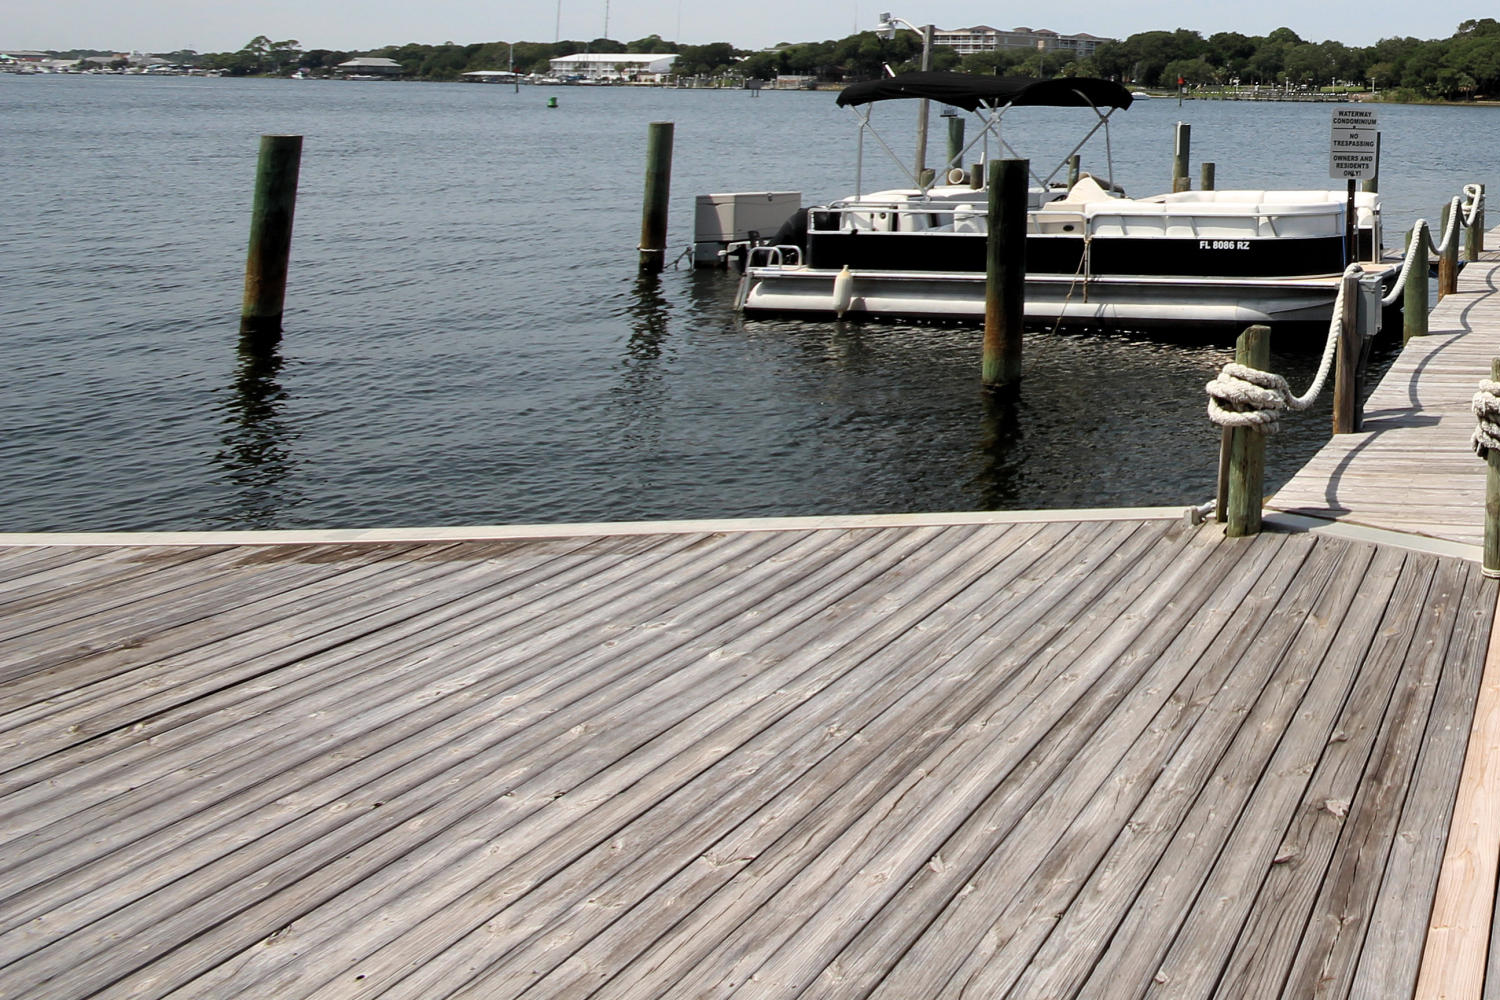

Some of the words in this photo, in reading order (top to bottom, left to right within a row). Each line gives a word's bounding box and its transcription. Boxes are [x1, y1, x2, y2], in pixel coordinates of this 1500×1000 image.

[1338, 110, 1372, 118] WATERWAY
[1332, 117, 1377, 125] CONDOMINIUM
[1333, 140, 1375, 148] TRESPASSING
[1332, 154, 1359, 162] OWNERS
[1335, 162, 1370, 170] RESIDENTS
[1199, 240, 1211, 250] FL
[1212, 240, 1235, 250] 8086
[1236, 241, 1251, 250] RZ
